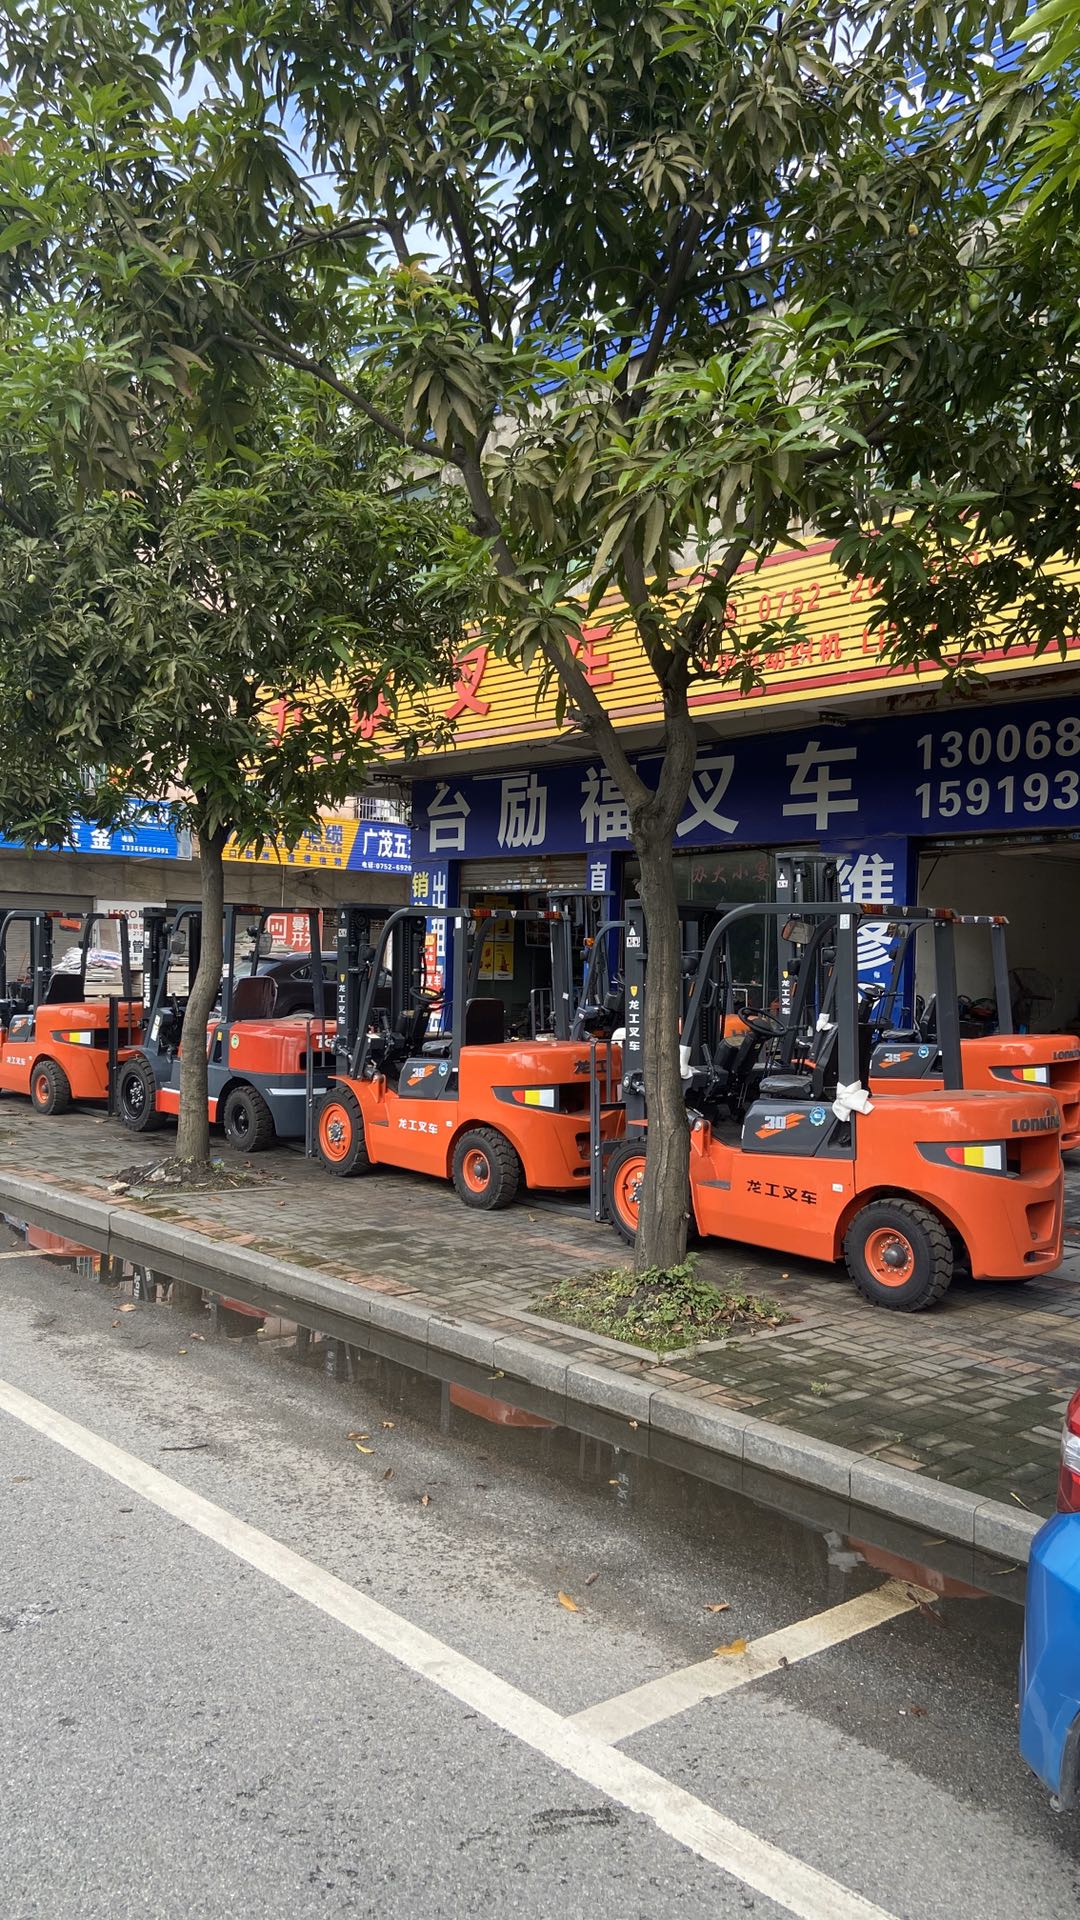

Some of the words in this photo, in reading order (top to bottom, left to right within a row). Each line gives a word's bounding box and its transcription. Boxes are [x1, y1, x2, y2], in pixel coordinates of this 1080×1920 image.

[916, 716, 1080, 770] 130068
[426, 740, 859, 853] 台励福叉车
[915, 770, 1080, 819] 159193
[362, 828, 411, 860] 广茂五
[412, 871, 429, 906] 销
[338, 984, 346, 1025] 龙工叉车
[780, 979, 791, 1015] 龙工叉车
[628, 1000, 640, 1051] 龙工叉车
[398, 1117, 439, 1135] 龙工叉车
[764, 1115, 786, 1130] 30
[747, 1179, 817, 1206] 龙工叉车
